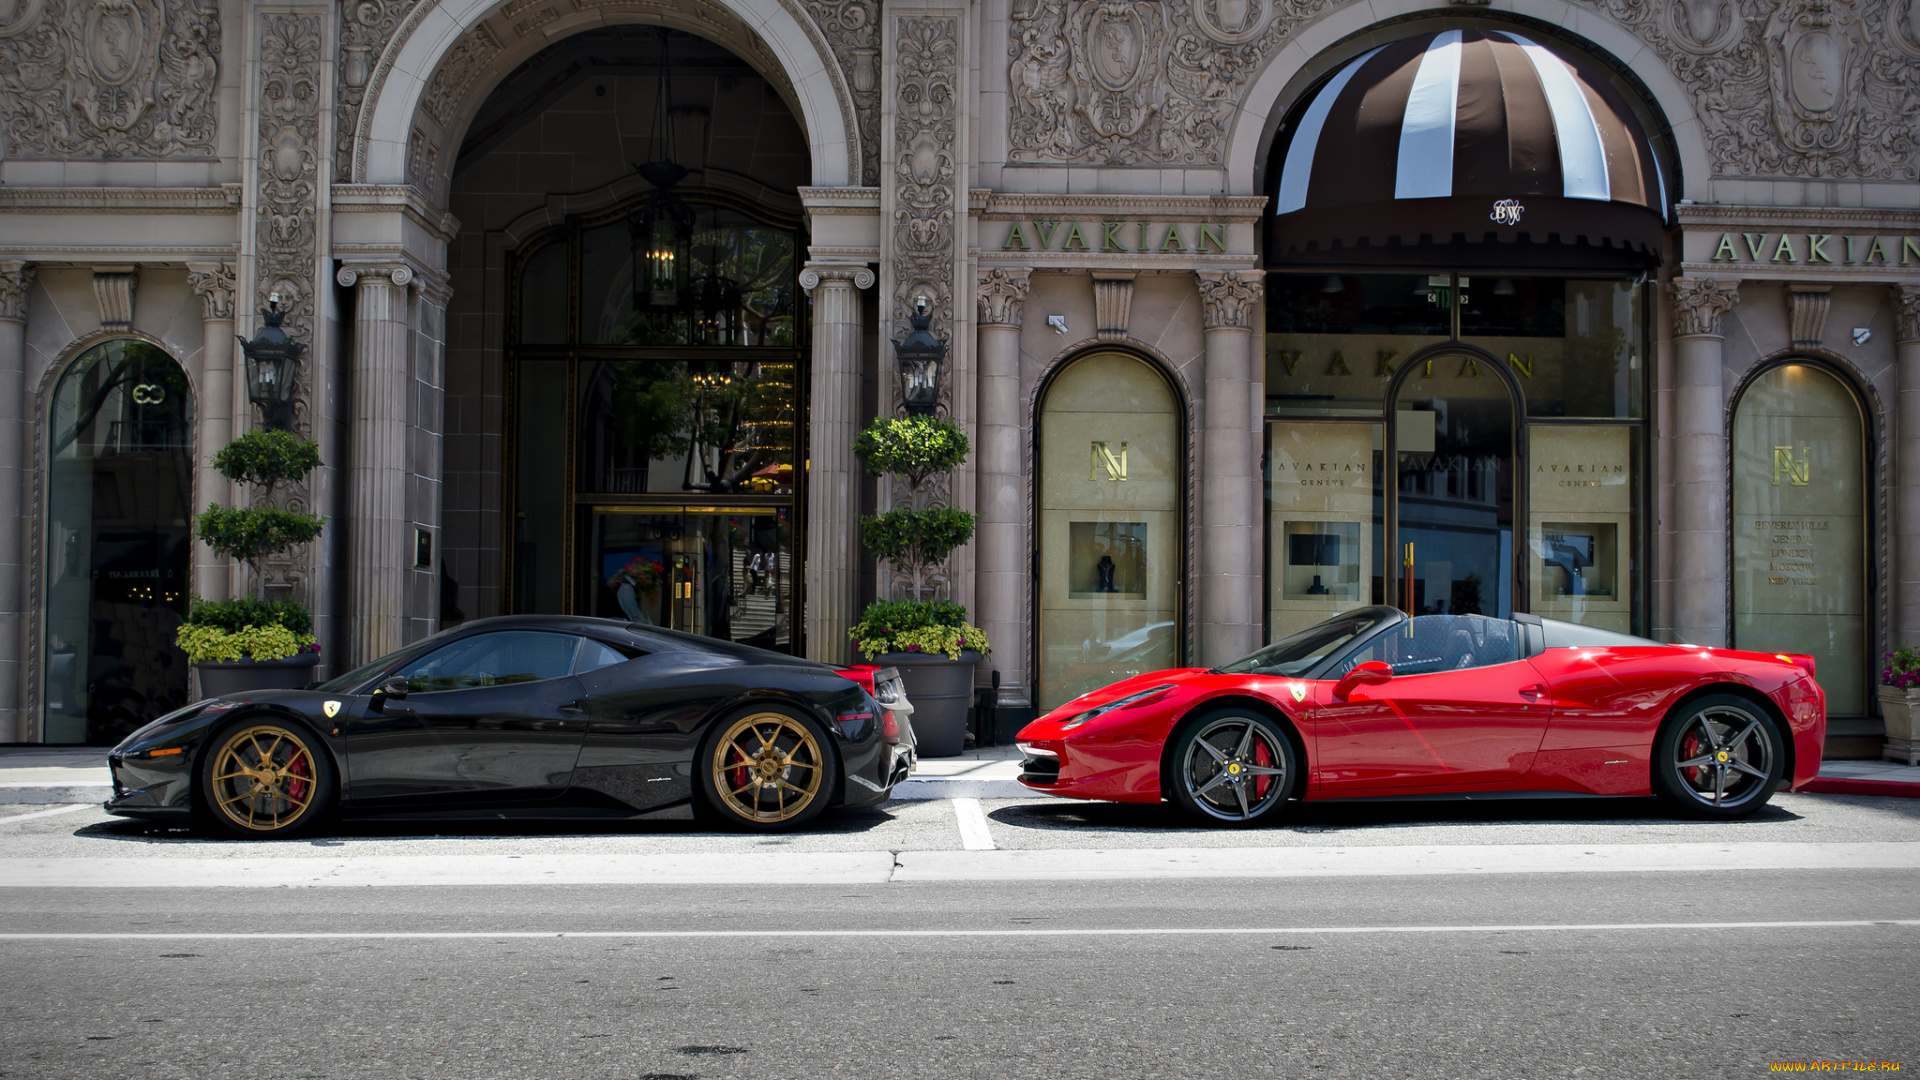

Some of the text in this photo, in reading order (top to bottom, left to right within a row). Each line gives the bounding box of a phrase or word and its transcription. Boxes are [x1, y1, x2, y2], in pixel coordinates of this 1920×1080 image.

[1003, 220, 1230, 252] AVAKIAN
[1279, 351, 1534, 380] VAKIAN
[1279, 462, 1366, 473] AVAKIAN
[1407, 456, 1501, 472] AVAKIAN
[1537, 464, 1623, 473] AVAKIAN
[1754, 520, 1830, 531] BEVERLY HILLS
[1771, 549, 1813, 558] LONDON
[1769, 563, 1814, 572] MOSCOW
[1768, 577, 1789, 586] NEW
